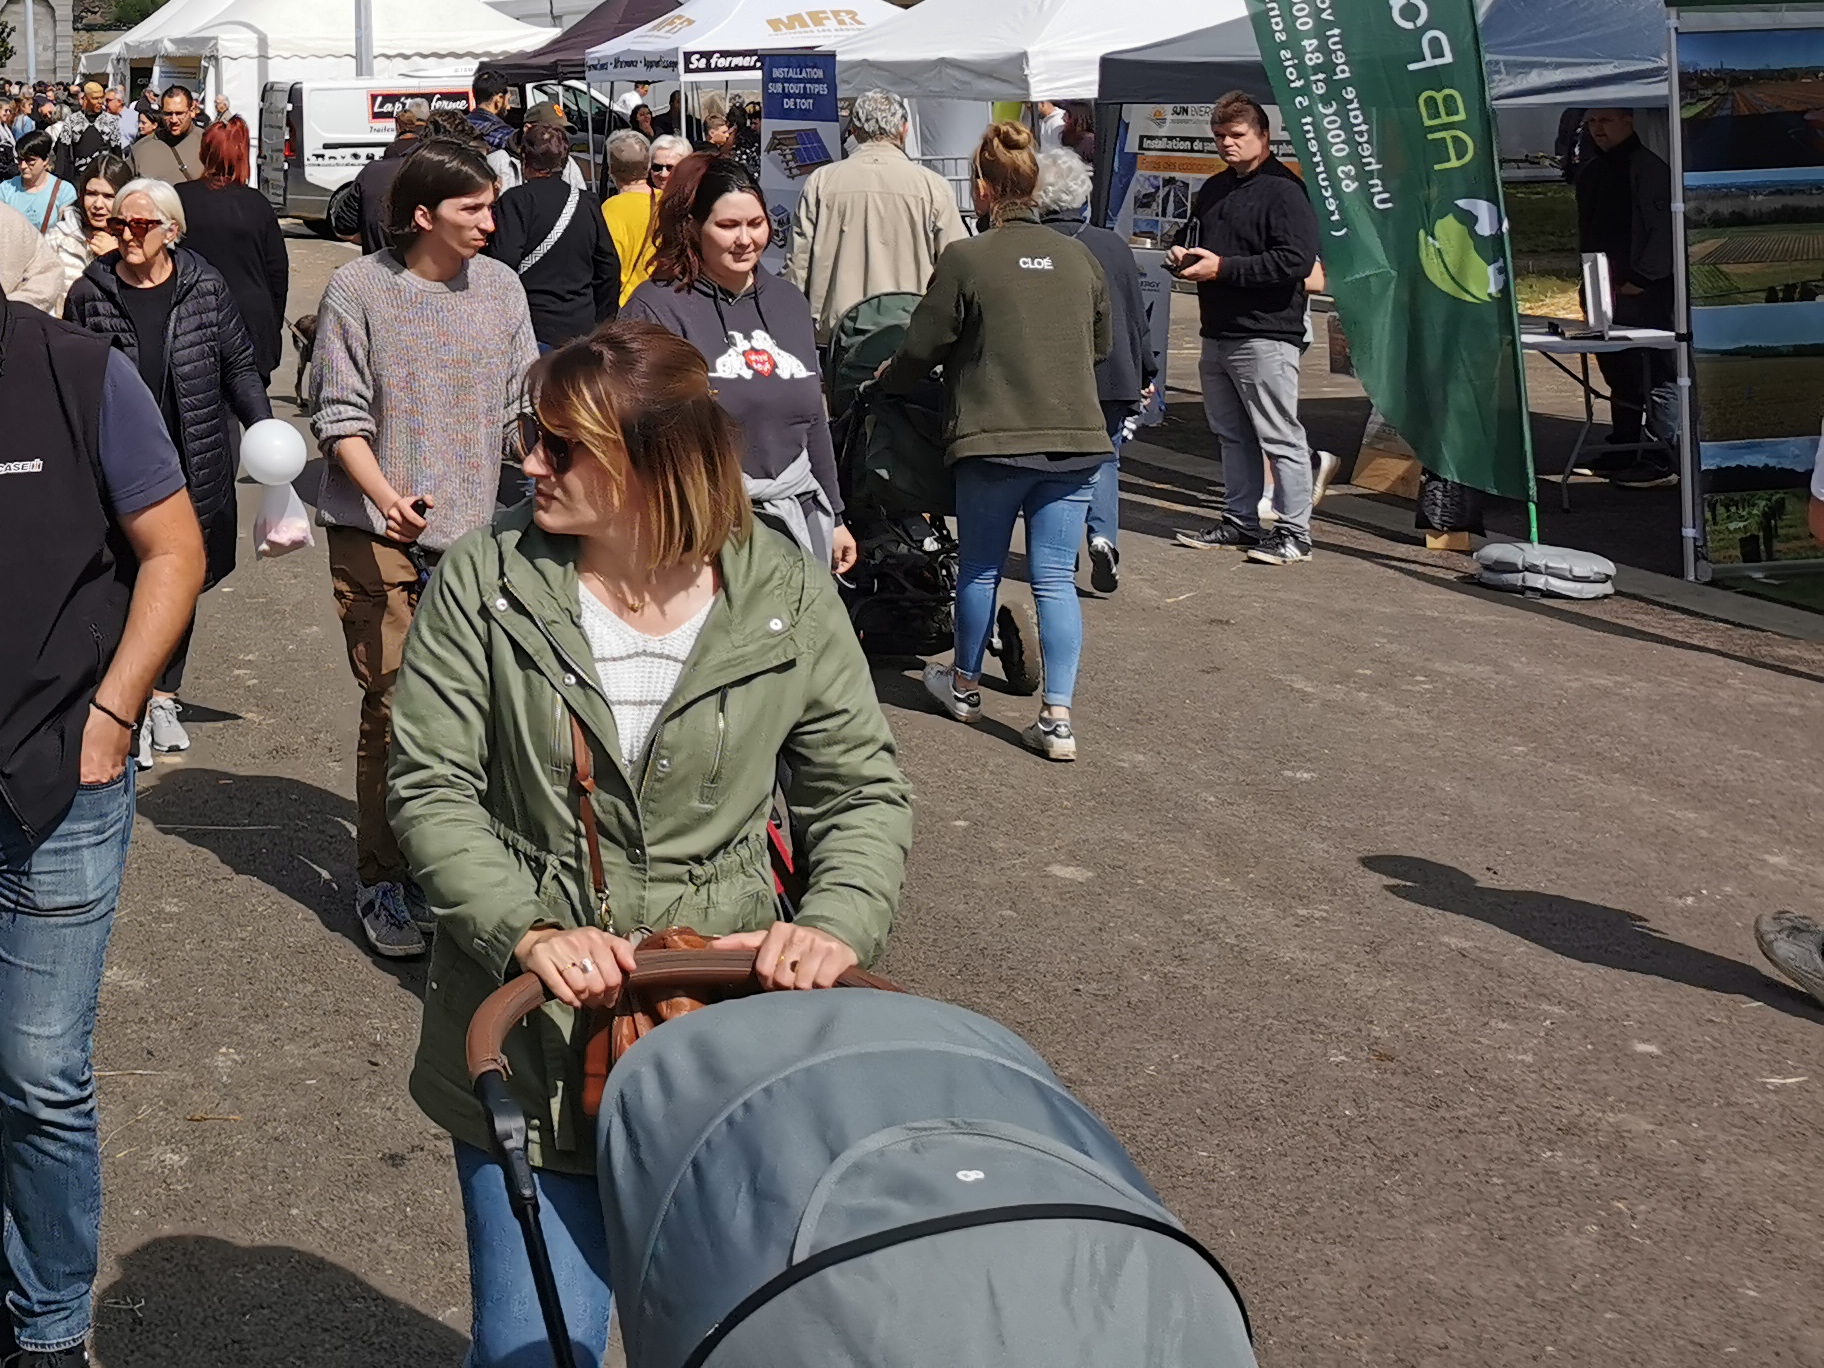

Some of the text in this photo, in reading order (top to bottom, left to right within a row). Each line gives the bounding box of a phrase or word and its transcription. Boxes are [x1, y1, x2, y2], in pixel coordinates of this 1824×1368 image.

[766, 9, 868, 32] MFR
[689, 53, 708, 70] Se
[772, 67, 824, 79] INSTALLATION
[768, 83, 828, 95] SUR TOUT TYPES
[430, 94, 469, 112] ferme
[783, 98, 813, 110] DE TOIT
[369, 125, 396, 134] Traiteu
[1019, 256, 1054, 270] CLOÉ
